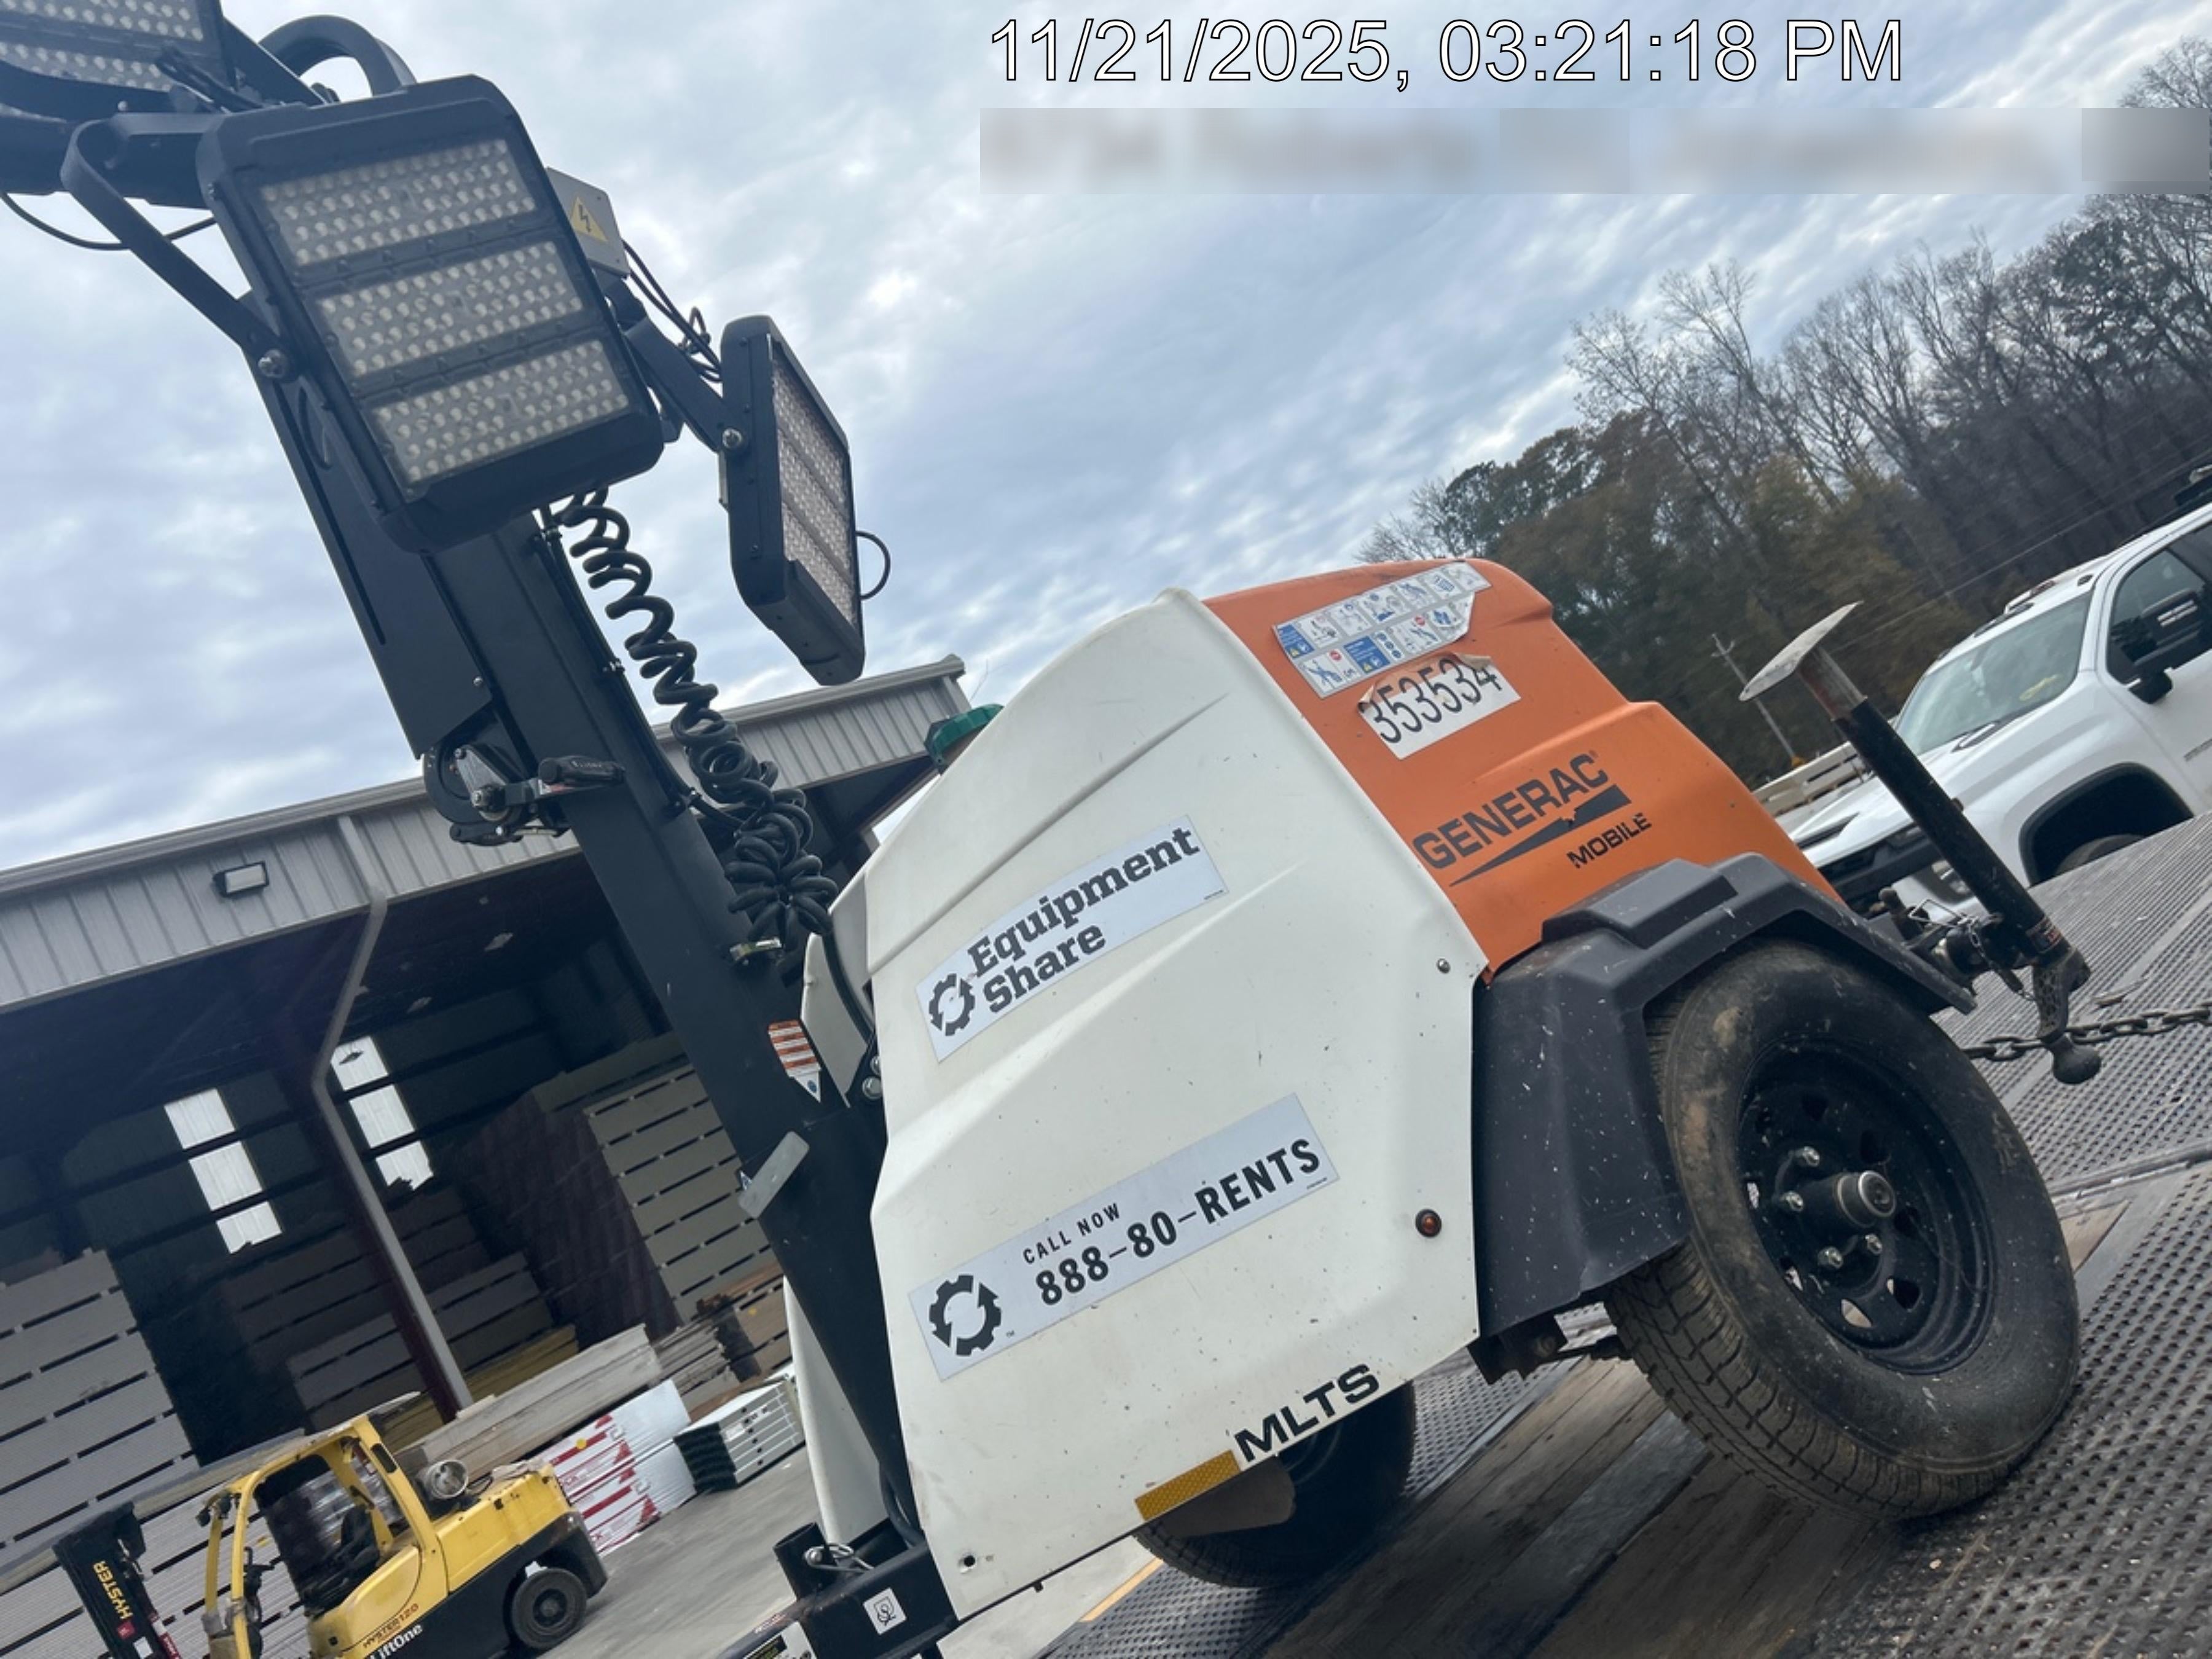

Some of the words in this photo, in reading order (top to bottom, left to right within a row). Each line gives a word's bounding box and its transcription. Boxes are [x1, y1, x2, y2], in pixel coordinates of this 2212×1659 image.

[1357, 657, 1502, 743] 353534
[1412, 753, 1609, 869] GENERAC
[1566, 812, 1652, 869] MOBILE
[967, 826, 1201, 978] Equipment
[982, 924, 1107, 1013] Share
[1022, 1230, 1072, 1264] CALL
[1077, 1202, 1121, 1237] NOW
[1035, 1138, 1320, 1306] 888-80-RENTS
[1234, 1363, 1379, 1462] MLTS
[93, 1561, 133, 1620] HYSTER
